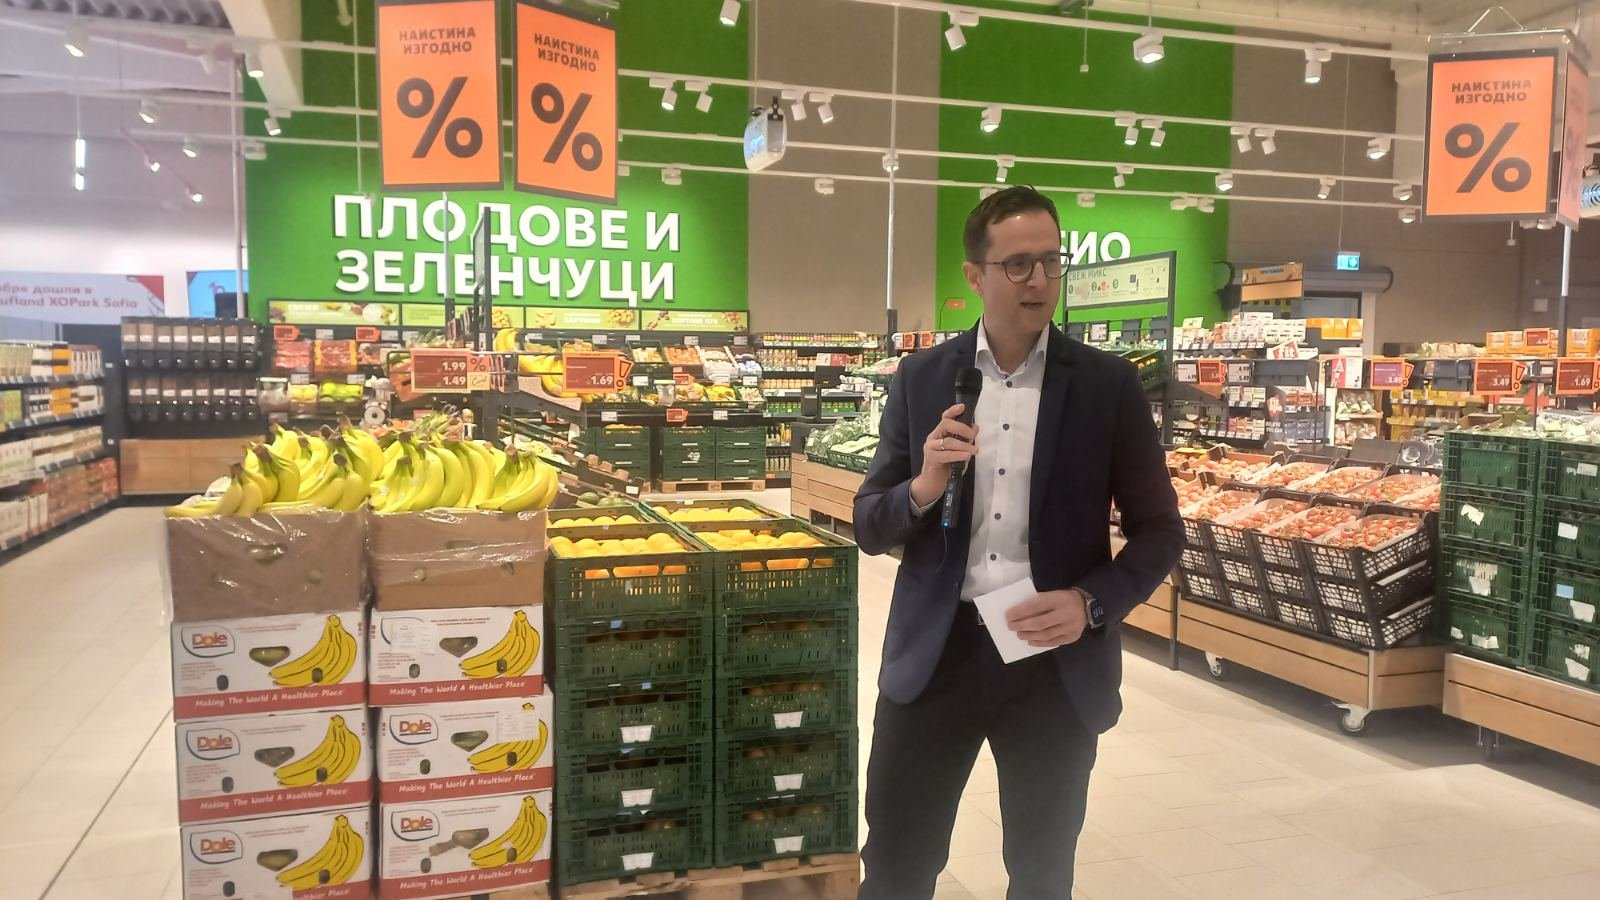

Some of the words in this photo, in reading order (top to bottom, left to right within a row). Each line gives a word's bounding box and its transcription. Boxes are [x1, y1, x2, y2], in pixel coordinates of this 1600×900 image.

[400, 26, 475, 41] НАИСТИНА
[403, 41, 472, 55] ИЗГОДНО
[534, 33, 600, 60] НАИСТИНА
[537, 48, 597, 73] ИЗГОДНО
[1451, 79, 1532, 93] НАИСТИНА
[1455, 92, 1527, 104] ИЗГОДНО
[396, 76, 483, 158] %
[531, 82, 603, 172] %
[1444, 122, 1532, 193] %
[334, 194, 628, 254] ПЛОДОВЕ
[646, 210, 681, 251] И
[335, 249, 675, 307] ЗЕЛЕНЧУЦИ
[0, 283, 28, 295] бре
[49, 297, 98, 307] XOPark
[104, 298, 137, 308] Sofia
[442, 361, 466, 371] 1.99
[442, 376, 466, 385] 1.49
[590, 375, 613, 385] 1.69
[1492, 378, 1510, 386] 3.49
[1574, 378, 1590, 386] 1.69
[192, 632, 228, 646] Dole
[389, 687, 417, 697] Making
[437, 684, 457, 692] World
[469, 681, 503, 690] Healthier
[195, 697, 225, 708] Making
[228, 696, 244, 705] The
[246, 694, 269, 703] World
[281, 690, 319, 700] Healthier
[321, 688, 345, 696] Place
[400, 719, 432, 733] Dole
[197, 735, 233, 748] Dole
[399, 783, 426, 792] Making
[429, 782, 443, 790] The
[446, 780, 466, 788] World
[477, 776, 512, 785] Healthier
[200, 800, 230, 810] Making
[233, 798, 249, 806] The
[251, 796, 274, 804] World
[286, 791, 323, 800] Healthier
[326, 788, 348, 796] Place
[400, 816, 433, 830] Dole
[200, 837, 236, 850] Dole
[400, 880, 427, 890] Making
[446, 877, 467, 885] World
[478, 872, 512, 881] Healthier
